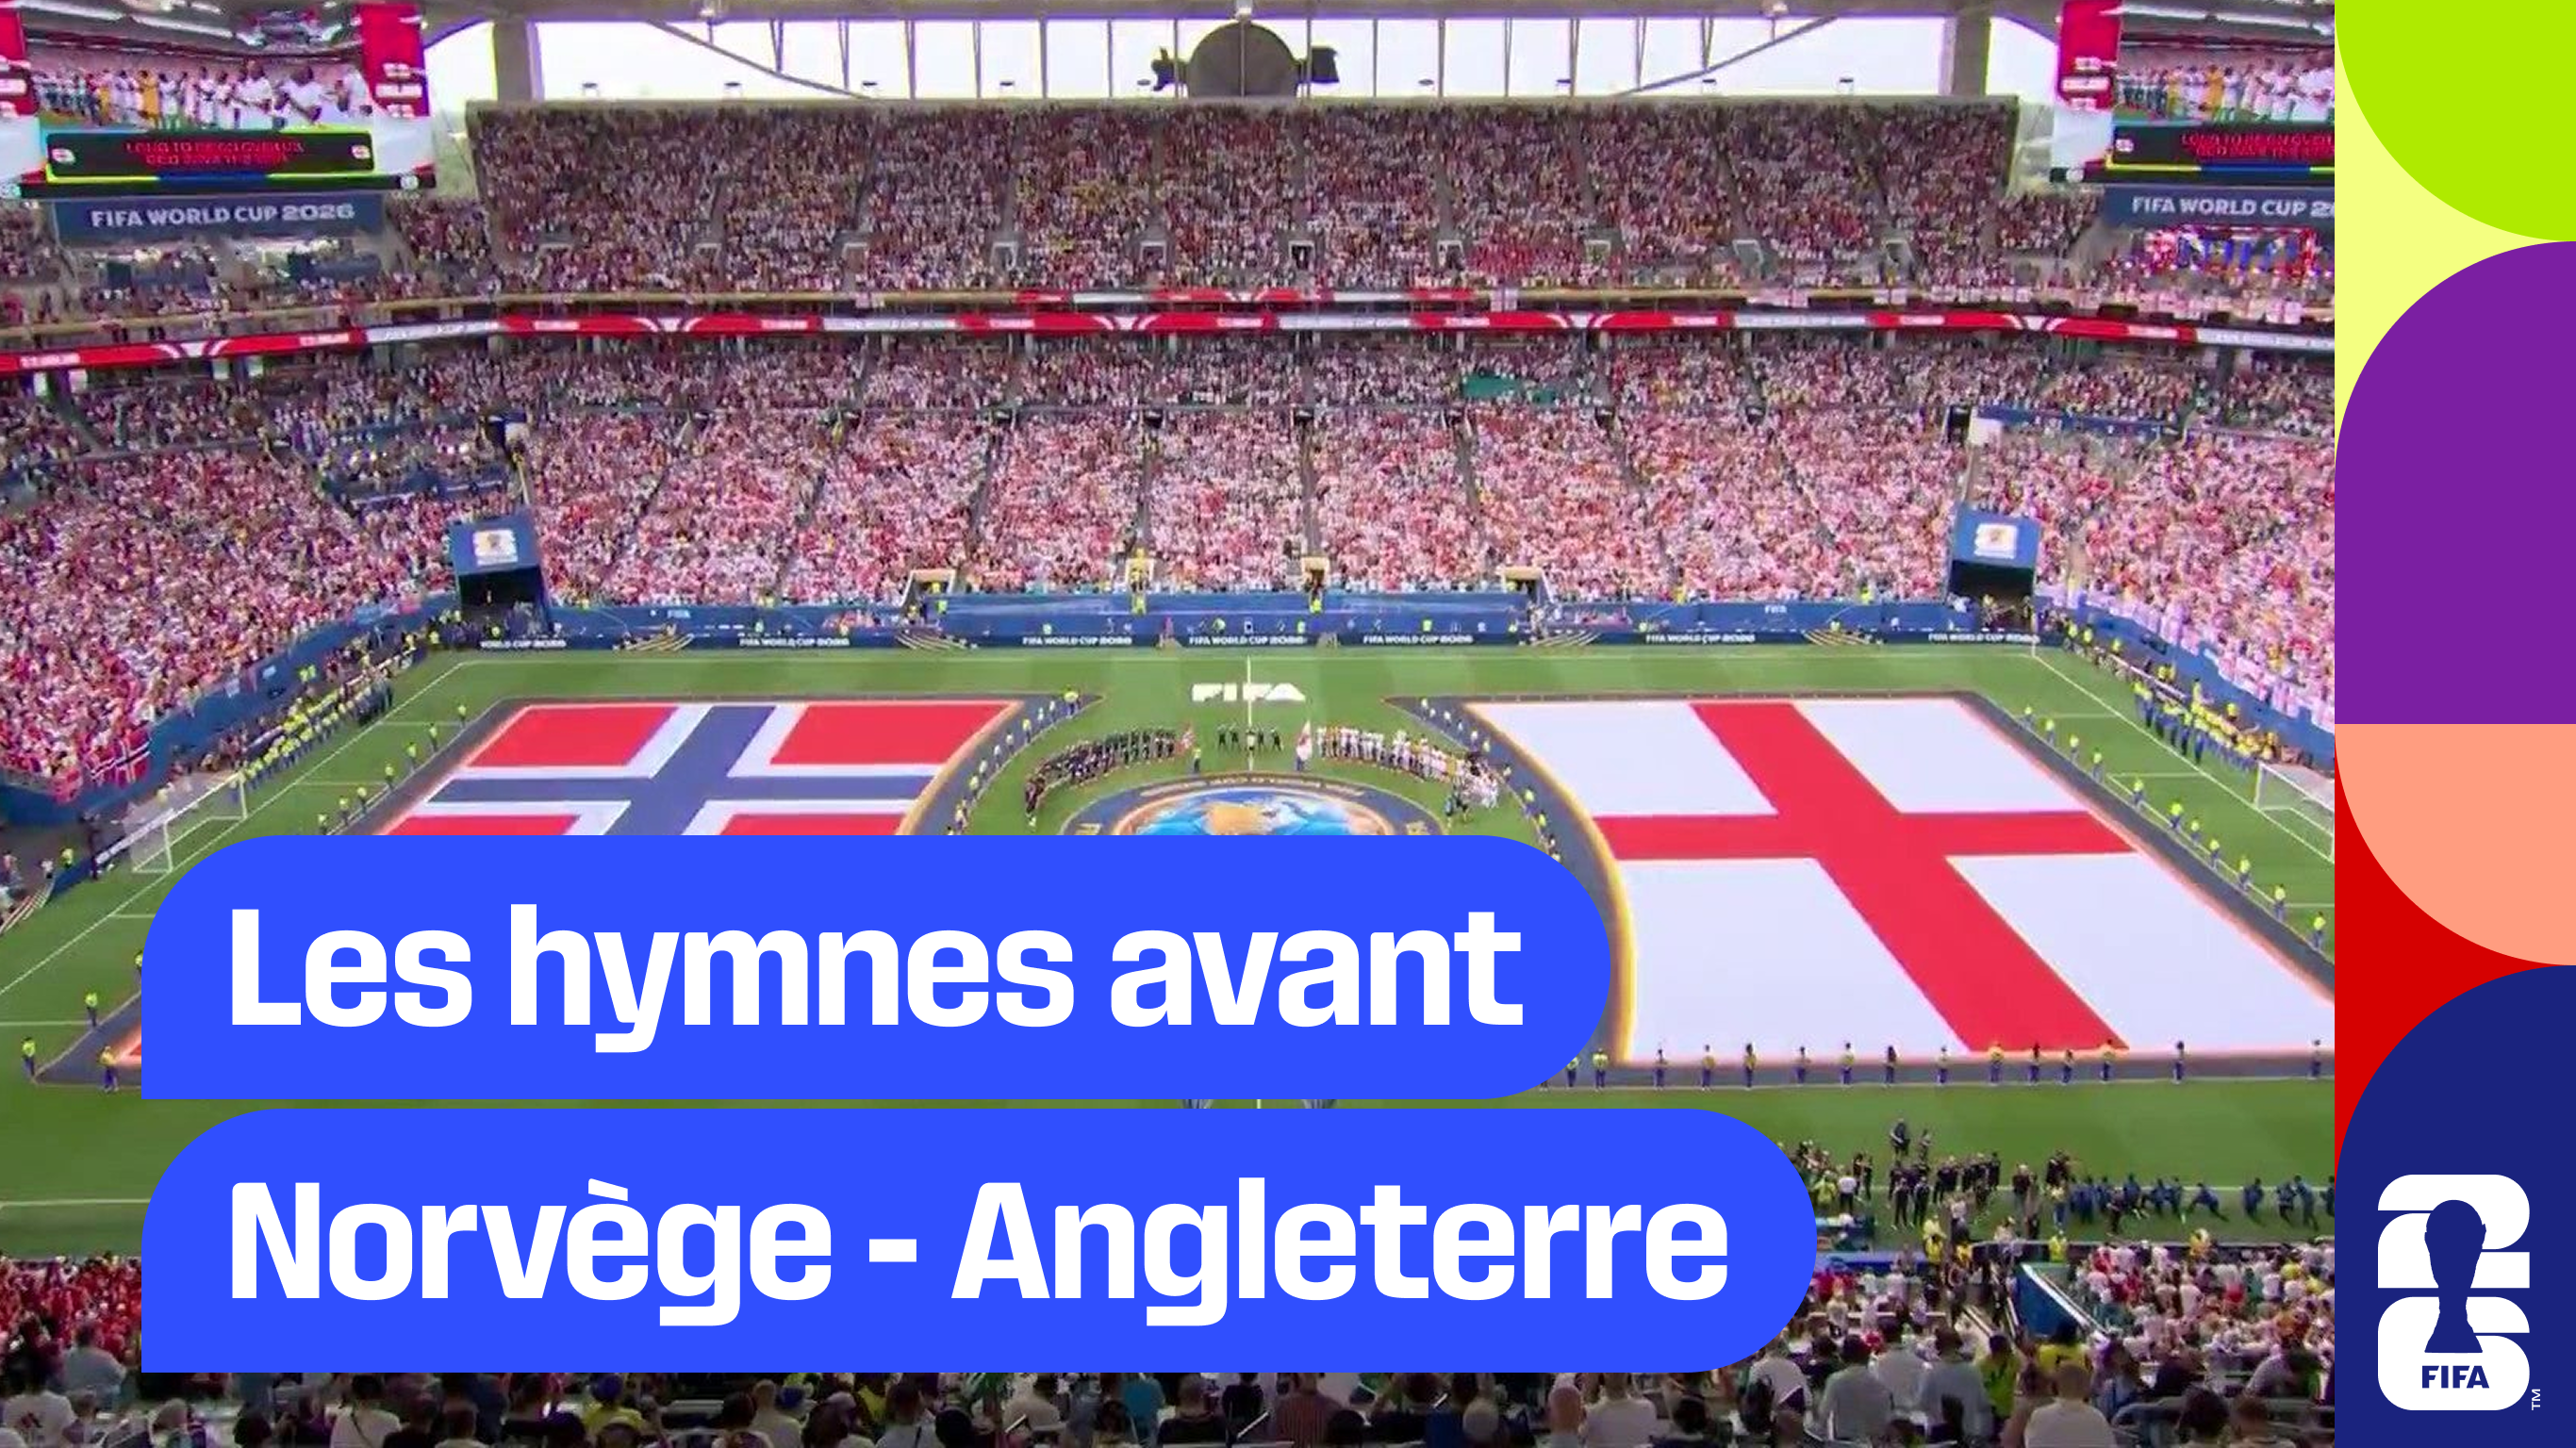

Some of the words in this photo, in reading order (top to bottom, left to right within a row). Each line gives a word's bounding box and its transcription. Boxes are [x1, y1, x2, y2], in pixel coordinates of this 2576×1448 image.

[2132, 196, 2175, 213] FIFA
[2179, 198, 2256, 215] WORLD
[2261, 199, 2307, 217] CUP
[91, 209, 142, 227] FIFA
[147, 206, 231, 226] WORLD
[235, 204, 277, 222] CUP
[282, 202, 355, 222] 2026
[1022, 636, 1043, 646] FIFA
[1044, 636, 1078, 646] WORLD
[1080, 636, 1098, 646] CUP
[1189, 636, 1211, 646] FIFA
[1212, 636, 1247, 646] WORLD
[1249, 636, 1267, 646] CUP
[1363, 634, 1384, 645] FIFA
[1385, 634, 1419, 645] WORLD
[1420, 634, 1439, 645] CUP
[1192, 683, 1306, 702] FIFA
